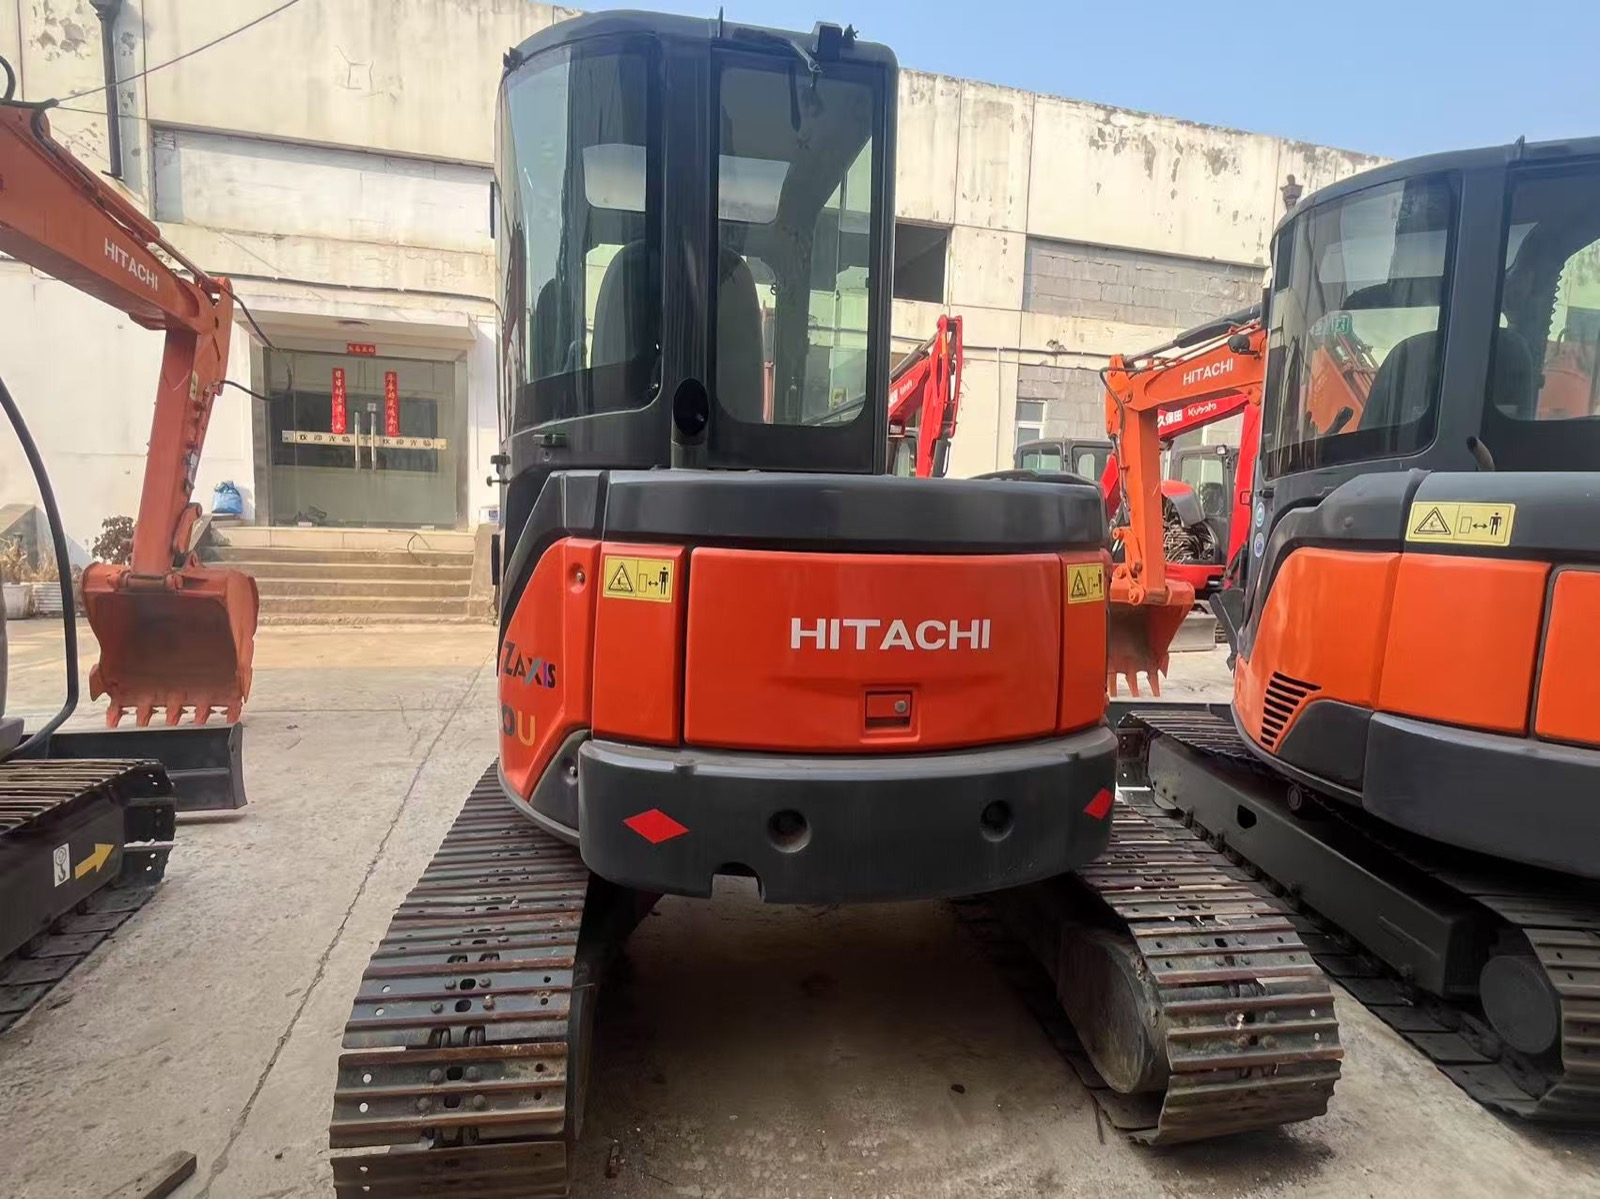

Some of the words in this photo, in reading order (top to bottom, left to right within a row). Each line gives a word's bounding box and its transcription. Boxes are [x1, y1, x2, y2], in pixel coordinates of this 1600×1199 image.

[104, 236, 158, 292] HITACHI
[1182, 357, 1234, 386] HITACHI
[1157, 409, 1183, 428] 久保田
[1187, 402, 1217, 417] Kubota
[790, 617, 991, 650] HITACHI
[503, 640, 556, 689] ZAXIS
